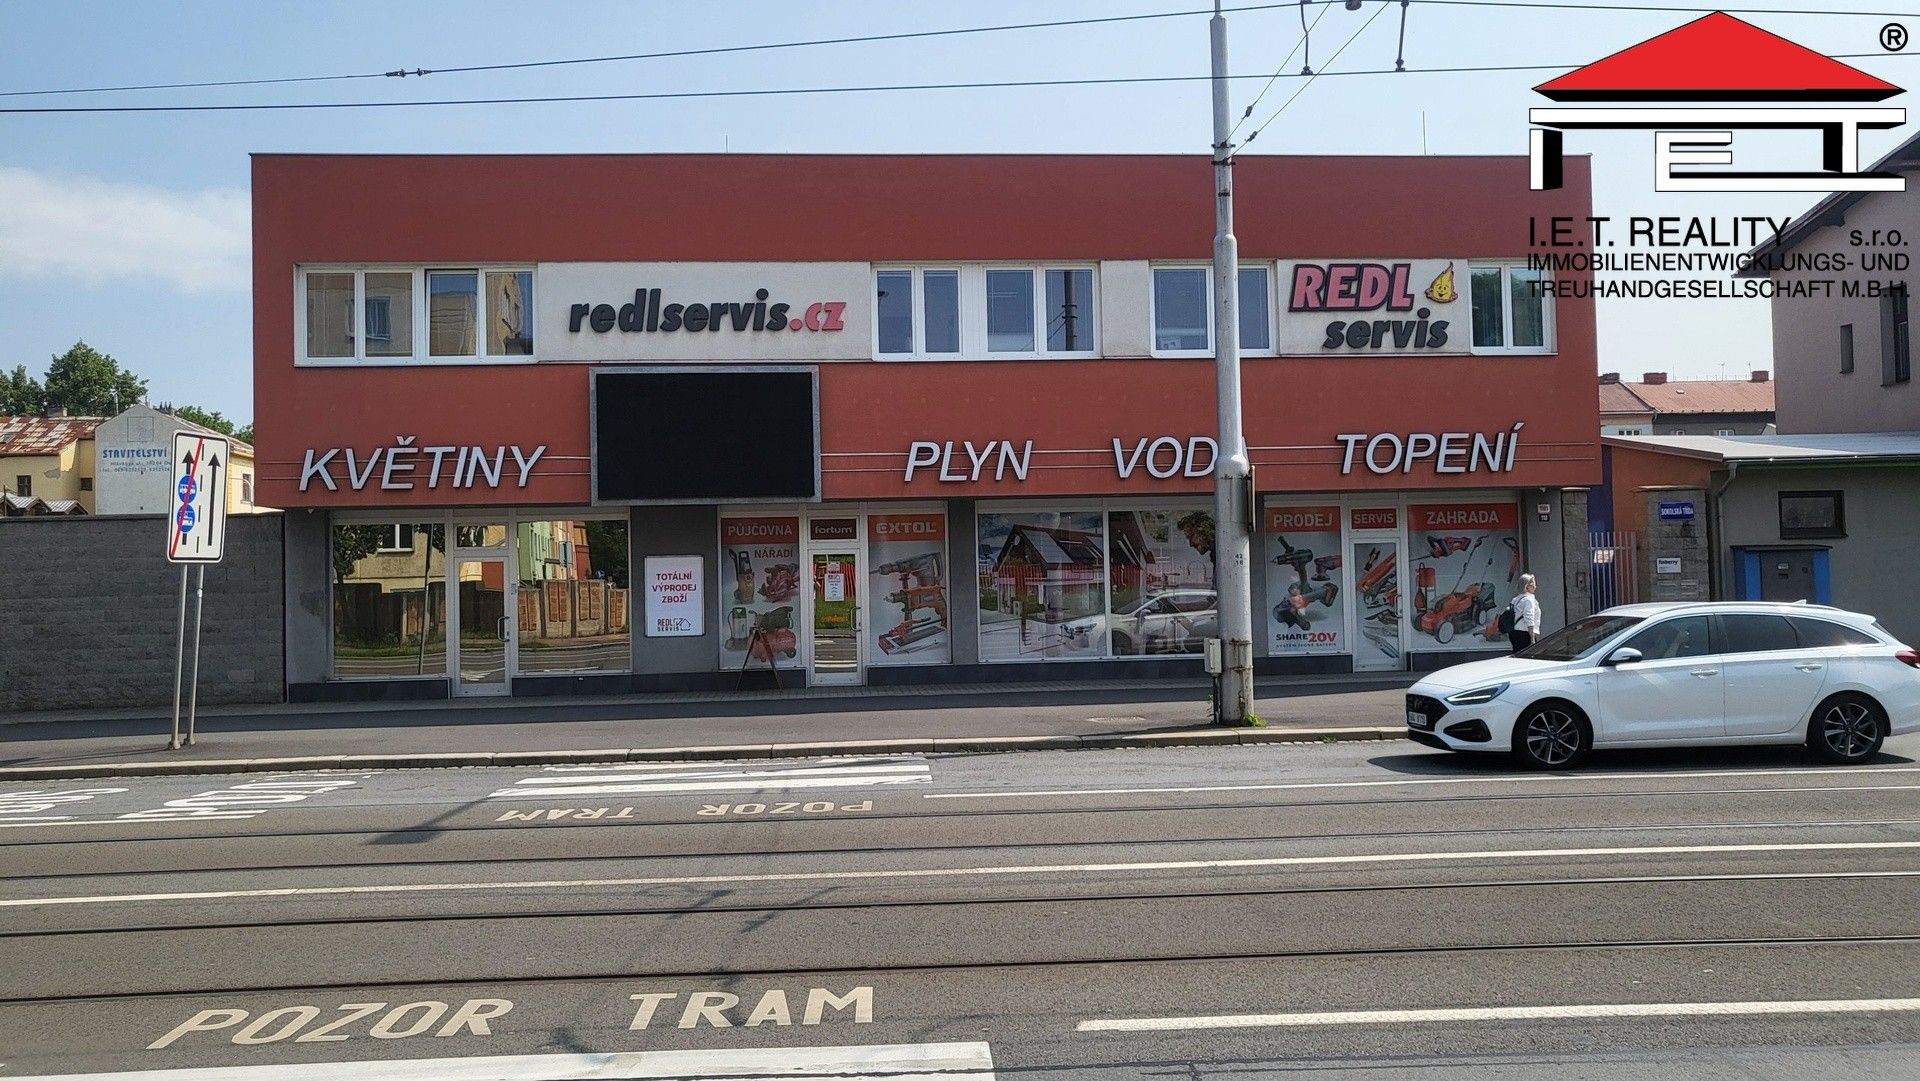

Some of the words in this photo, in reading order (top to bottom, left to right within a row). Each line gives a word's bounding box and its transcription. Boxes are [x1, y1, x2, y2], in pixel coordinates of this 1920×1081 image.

[1288, 263, 1415, 312] REDL
[568, 288, 847, 333] redlservis.cz
[1322, 307, 1450, 349] servis
[103, 447, 167, 458] STAVITELSTVÍ
[1337, 422, 1525, 474] TOPENÍ
[299, 436, 546, 491] KVĚTINY
[904, 440, 1033, 482] PLYN
[1113, 436, 1249, 479] VOD
[1273, 513, 1333, 528] PRODEJ
[1353, 513, 1394, 524] SERVIS
[1426, 510, 1499, 524] ZAHRADA
[815, 525, 852, 534] fortum
[876, 522, 937, 534] EXTOL
[754, 546, 793, 558] NÁŘADÍ
[656, 571, 692, 581] TOTÁLNÍ
[652, 582, 697, 592] VÝPRODEJ
[662, 593, 687, 603] ZBOŽÍ
[657, 618, 673, 627] REDL
[697, 800, 872, 816] POZOR
[147, 998, 514, 1050] POZOR
[629, 986, 873, 1030] TRAM
